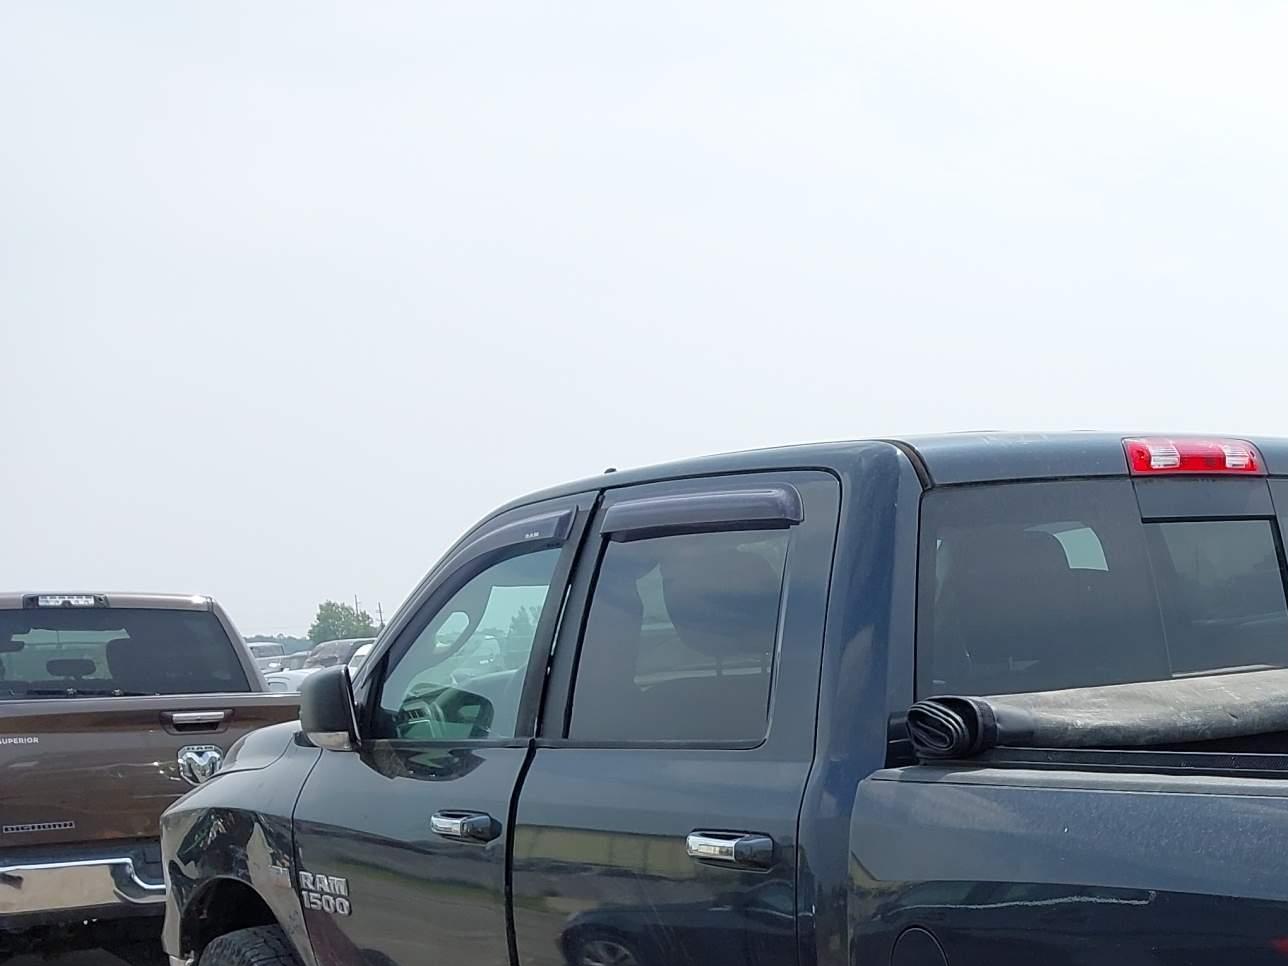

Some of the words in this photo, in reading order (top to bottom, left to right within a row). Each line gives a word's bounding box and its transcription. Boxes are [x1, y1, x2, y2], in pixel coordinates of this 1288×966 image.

[0, 736, 39, 744] UPERIOR
[299, 870, 350, 897] RAM
[301, 890, 352, 916] 1500
